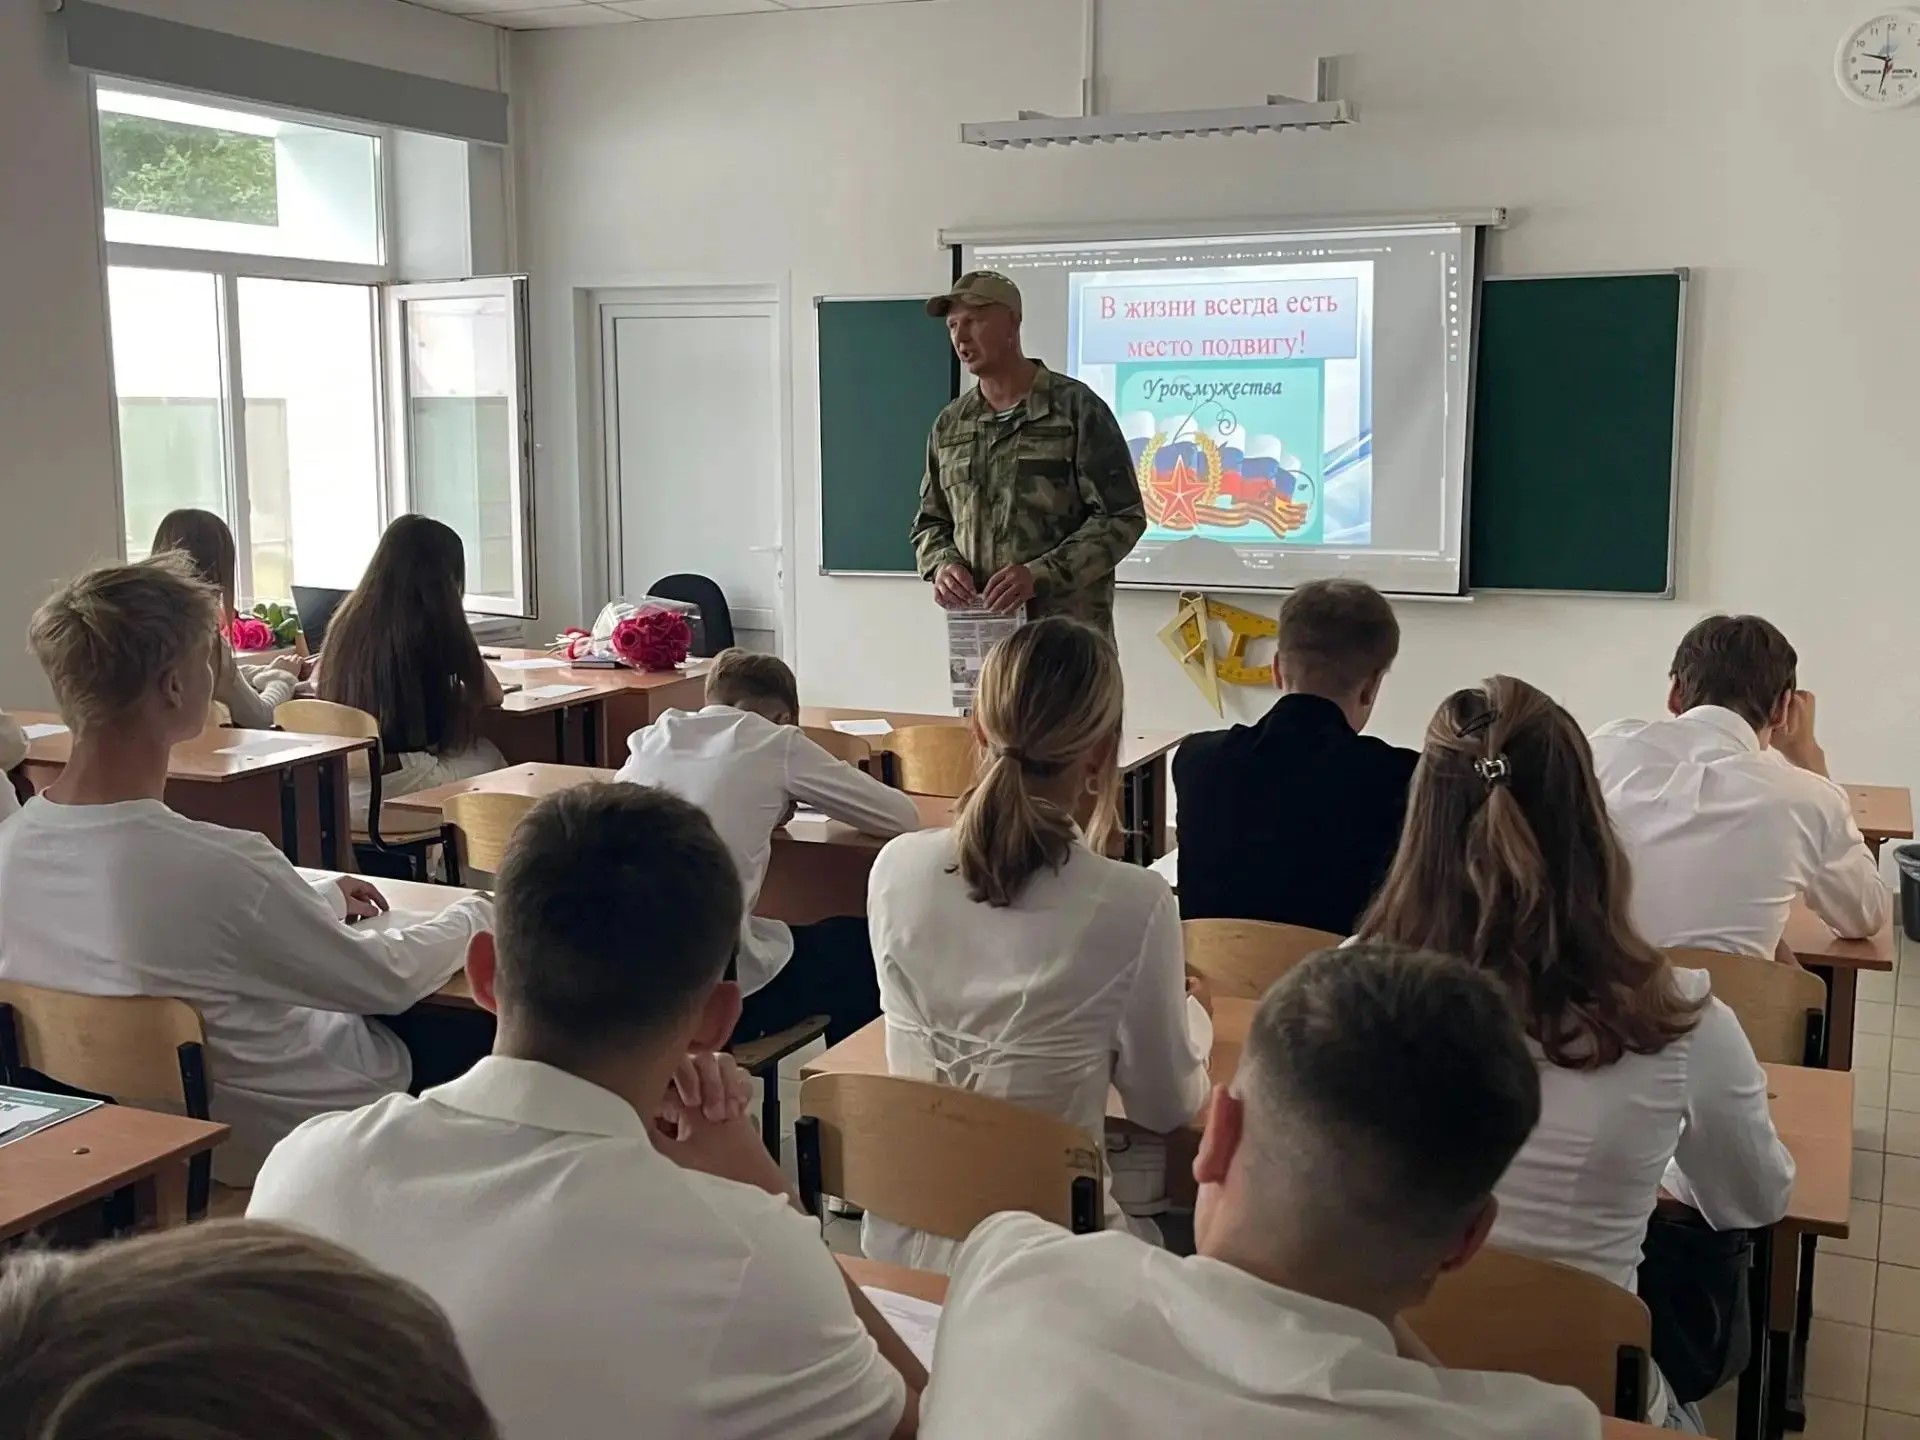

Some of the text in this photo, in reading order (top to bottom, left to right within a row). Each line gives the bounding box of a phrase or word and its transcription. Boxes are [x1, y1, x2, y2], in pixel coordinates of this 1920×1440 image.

[1856, 40, 1866, 48] 10
[1100, 294, 1338, 319] В жизни всегда есть
[1127, 330, 1305, 360] место подвигу!
[1143, 378, 1283, 402] Урок мужества
